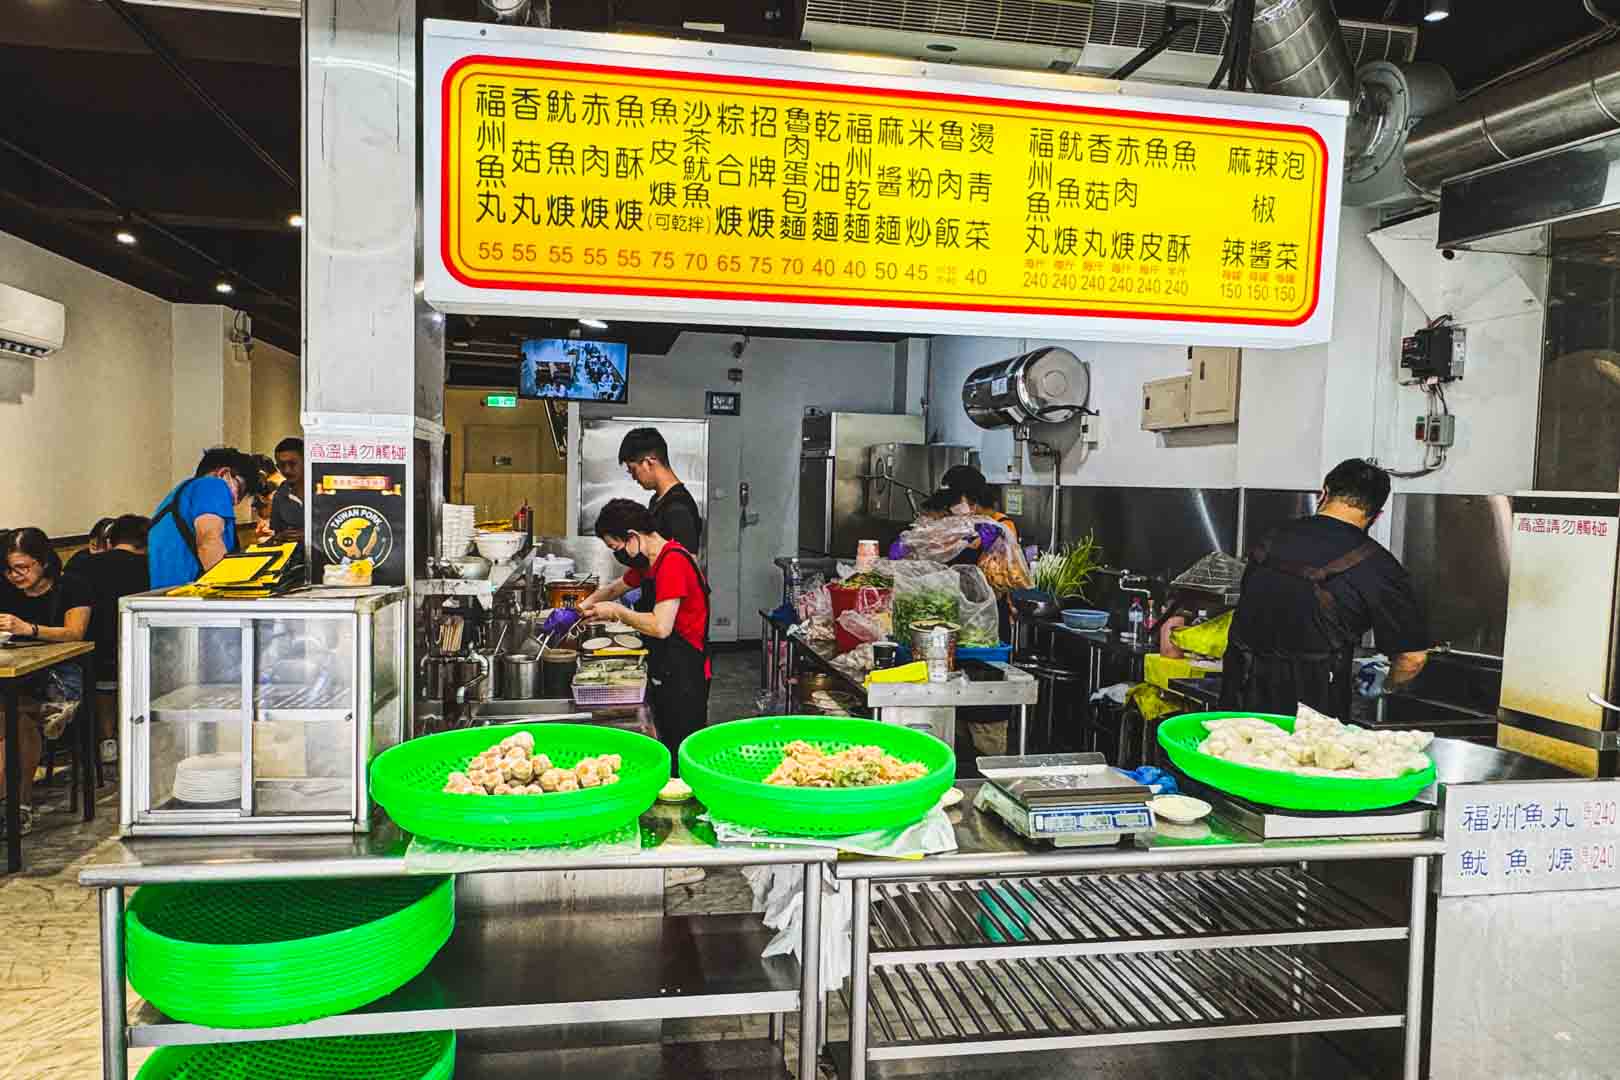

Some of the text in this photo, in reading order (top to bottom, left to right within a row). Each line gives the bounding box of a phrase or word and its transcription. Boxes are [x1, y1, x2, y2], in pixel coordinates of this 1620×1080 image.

[476, 84, 506, 223] 福州魚丸
[512, 88, 541, 224] 香菇丸
[546, 90, 576, 227] 魷魚焿
[581, 92, 609, 230] 赤肉焿
[682, 100, 711, 208] 沙茶魷魚
[615, 95, 644, 231] 魚酥焿
[748, 105, 777, 239] 招牌焿
[779, 107, 811, 240] 魯肉蛋包麵
[811, 110, 840, 242] 乾油麵
[843, 113, 872, 243] 福州乾麵
[875, 117, 904, 245] 麻醬麵
[905, 119, 934, 247] 米粉炒
[935, 120, 964, 248] 魯肉飯
[965, 122, 994, 250] 燙青菜
[1024, 128, 1054, 254] 福州魚丸
[1082, 133, 1111, 258] 香菇丸
[479, 242, 503, 261] 55
[512, 244, 537, 261] 55
[550, 246, 573, 263] 55
[584, 248, 607, 265] 55
[617, 250, 641, 267] 55
[652, 251, 674, 269] 75
[685, 253, 707, 271] 70
[717, 255, 740, 273] 65
[751, 256, 772, 273] 75
[782, 258, 803, 274] 70
[813, 259, 834, 276] 40
[843, 261, 865, 278] 40
[876, 262, 897, 279] 50
[905, 264, 928, 281] 45
[965, 270, 987, 285] 40
[1024, 272, 1048, 289] 240
[1052, 273, 1076, 290] 240
[1080, 274, 1104, 291] 240
[1110, 276, 1132, 293] 240
[1137, 278, 1160, 294] 240
[1164, 279, 1188, 296] 240
[1221, 283, 1242, 299] 150
[1248, 285, 1270, 301] 150
[1274, 286, 1296, 302] 150
[330, 509, 383, 528] TAIWAN PORK
[1463, 802, 1575, 832] 福州魚丸
[1593, 801, 1616, 825] 240
[1592, 845, 1615, 870] 240
